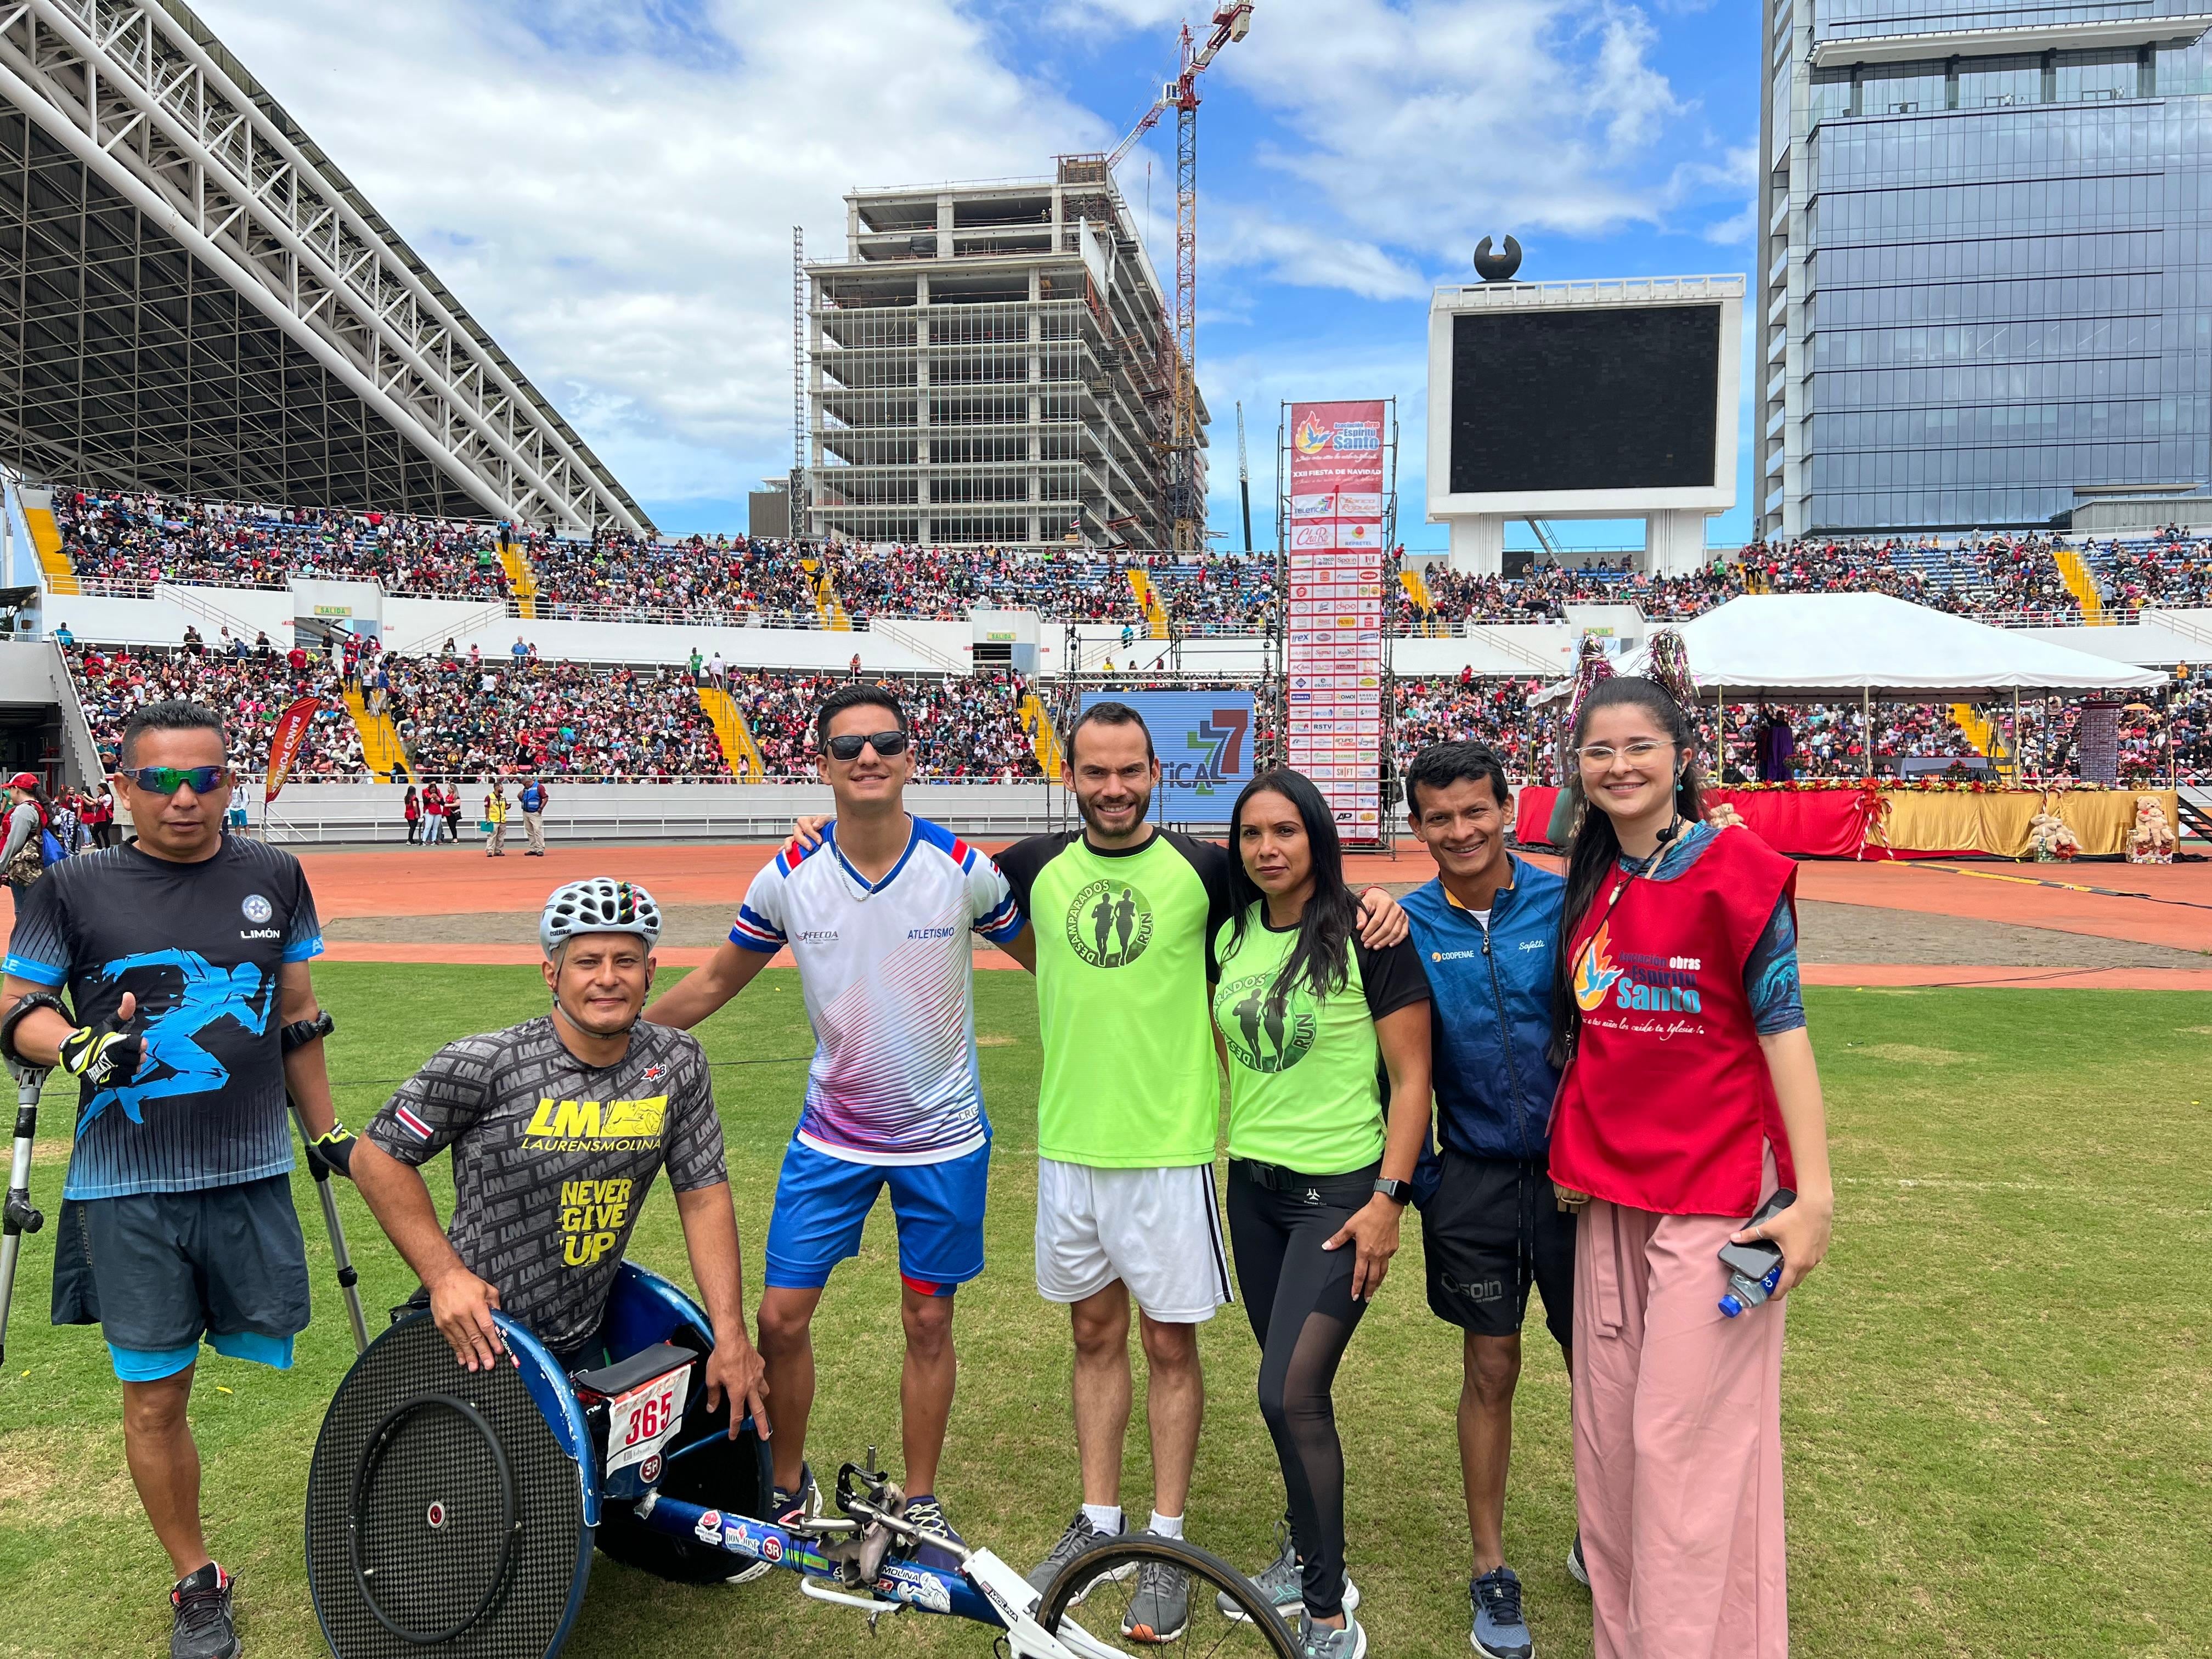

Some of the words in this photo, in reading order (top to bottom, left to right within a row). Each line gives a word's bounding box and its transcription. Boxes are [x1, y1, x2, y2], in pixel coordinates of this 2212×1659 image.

[1344, 428, 1376, 436] Espíritu
[1333, 436, 1379, 450] Santo
[283, 715, 302, 750] BANCO
[1068, 879, 1110, 963] DESAMPARADOS
[1136, 912, 1153, 946] RUN
[240, 927, 281, 939] LIMÓN
[808, 930, 839, 939] FECOA
[907, 926, 955, 940] ATLETISMO
[1441, 950, 1475, 961] COOPENAE
[1519, 939, 1545, 953] Safetti
[1618, 950, 1667, 967] Asociación
[1669, 955, 1701, 970] obras
[1632, 964, 1697, 987] Espíritu
[1616, 976, 1702, 1014] Santo
[1291, 1013, 1316, 1051] RUN
[1601, 1019, 1618, 1029] niños
[1618, 1016, 1629, 1030] los
[1630, 1018, 1655, 1033] cuida
[1655, 1024, 1664, 1032] tu
[1659, 1019, 1696, 1041] Iglesia
[517, 1041, 542, 1060] LM
[430, 1081, 456, 1099] LM
[495, 1071, 522, 1097] LM
[524, 1098, 600, 1138] LM
[521, 1137, 661, 1152] LAURENSMOLINA
[500, 1146, 531, 1167] LM
[687, 1148, 714, 1176] LM
[535, 1156, 565, 1181] LM
[483, 1177, 506, 1198] LM
[561, 1178, 633, 1206] NEVER
[523, 1187, 553, 1210] LM
[561, 1202, 629, 1232] GIVE
[500, 1220, 528, 1244] LM
[563, 1231, 617, 1266] UP
[491, 1250, 516, 1274] LM
[519, 1261, 547, 1285] LM
[500, 1336, 513, 1357] MOLINA
[625, 1390, 673, 1446] 365
[644, 1458, 659, 1476] 3R
[726, 1533, 740, 1543] DON
[741, 1538, 758, 1550] JOSÉ
[765, 1542, 780, 1558] 3R
[882, 1565, 920, 1584] MOLINA
[989, 1590, 1018, 1622] MOLINA
